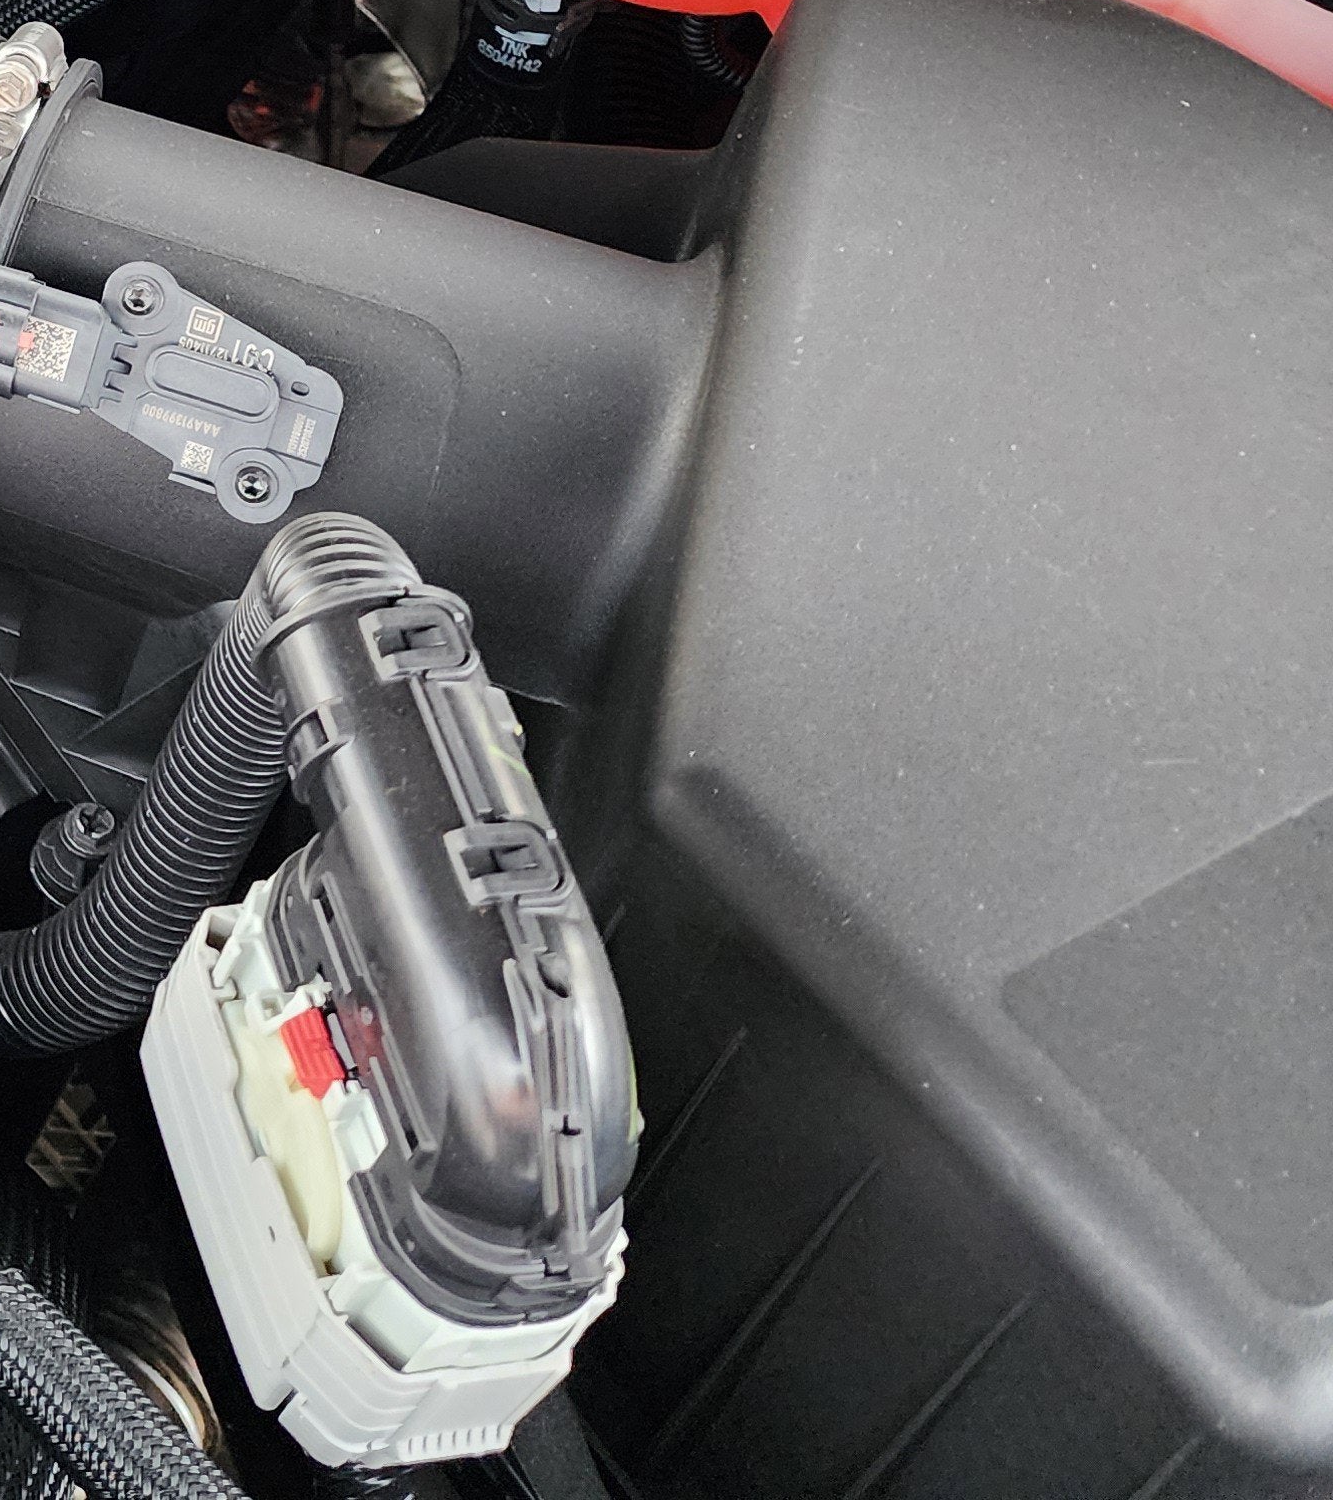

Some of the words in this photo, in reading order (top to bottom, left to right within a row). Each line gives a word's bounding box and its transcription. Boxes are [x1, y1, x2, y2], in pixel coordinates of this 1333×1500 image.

[477, 38, 543, 73] 85044142
[501, 36, 531, 59] TNK
[192, 313, 217, 335] gm
